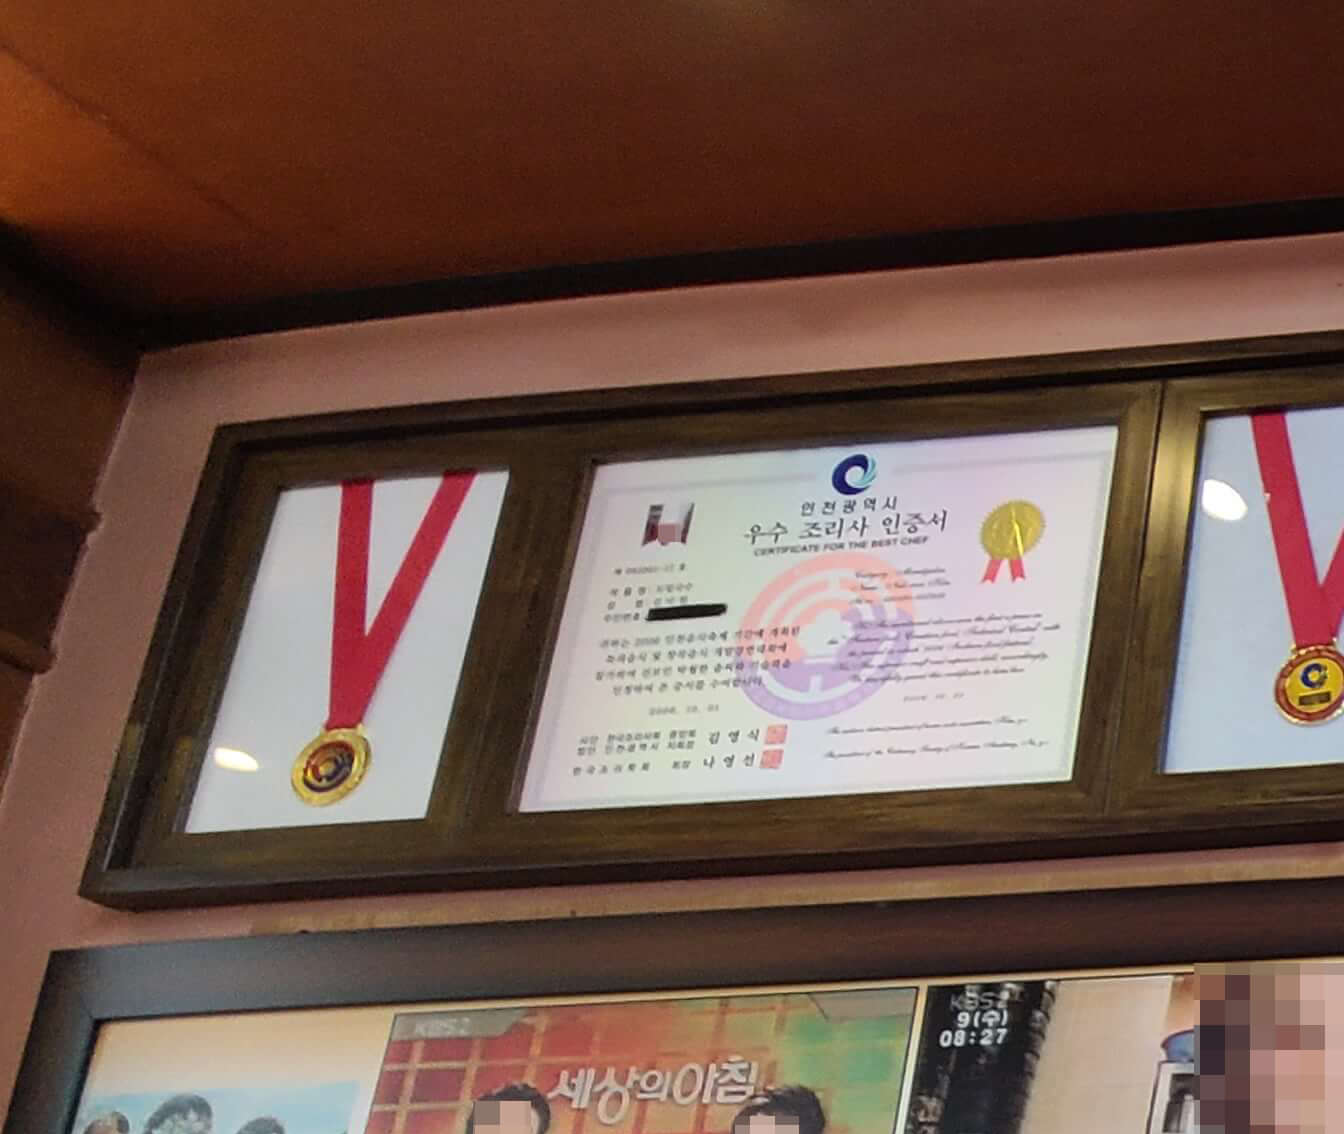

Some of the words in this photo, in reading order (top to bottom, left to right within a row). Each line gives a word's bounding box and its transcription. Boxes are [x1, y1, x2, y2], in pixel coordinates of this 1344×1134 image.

[743, 521, 788, 545] 우수
[798, 515, 870, 539] 조리사
[881, 509, 948, 535] 인증서
[753, 544, 820, 556] CERTIFICATE
[822, 542, 845, 551] FOR
[848, 540, 868, 549] THE
[871, 538, 898, 548] BEST
[899, 536, 928, 546] CHEF
[957, 1009, 1008, 1028] 9(수)
[940, 1028, 1008, 1047] 08:27
